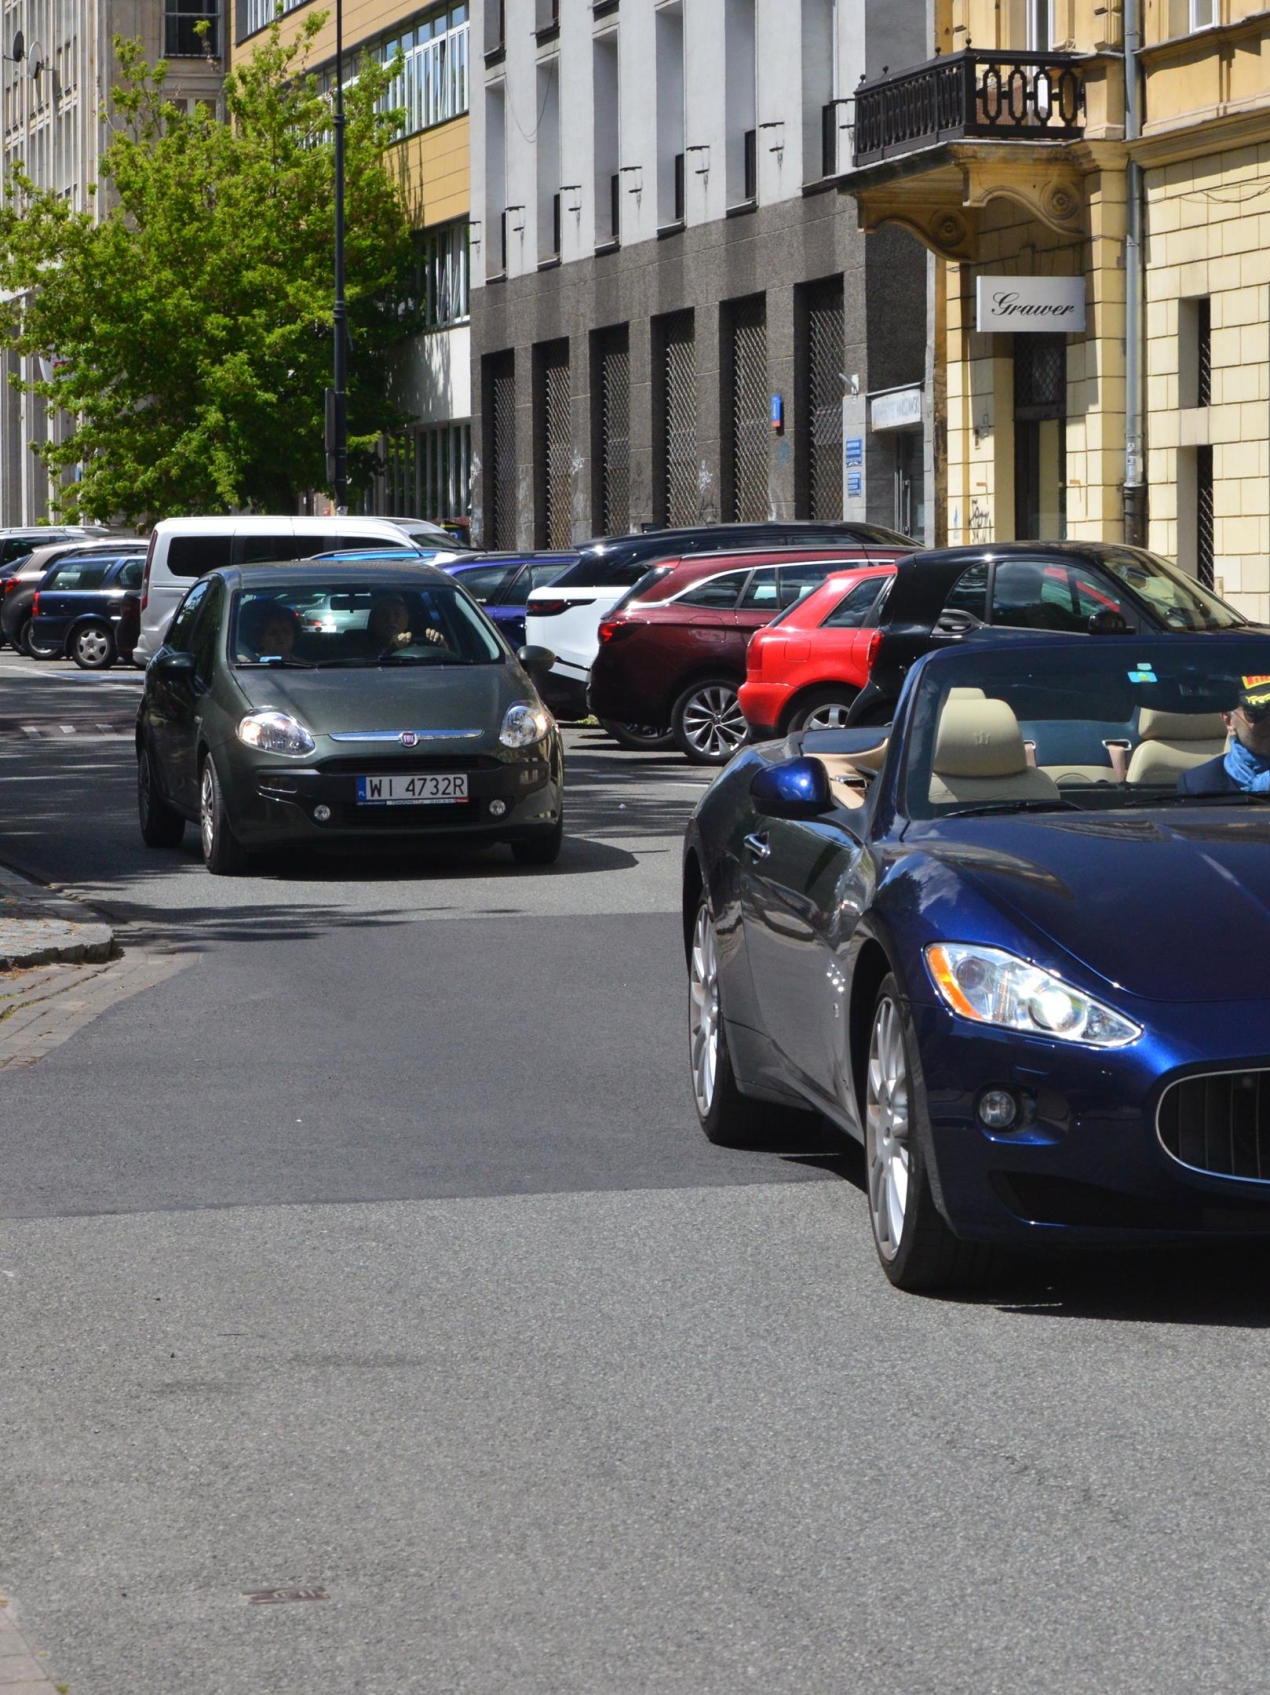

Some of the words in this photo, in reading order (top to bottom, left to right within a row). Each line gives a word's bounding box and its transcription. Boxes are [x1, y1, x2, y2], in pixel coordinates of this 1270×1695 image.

[991, 291, 1075, 316] Grawer
[369, 778, 393, 798] WI
[405, 776, 465, 797] 4732R
